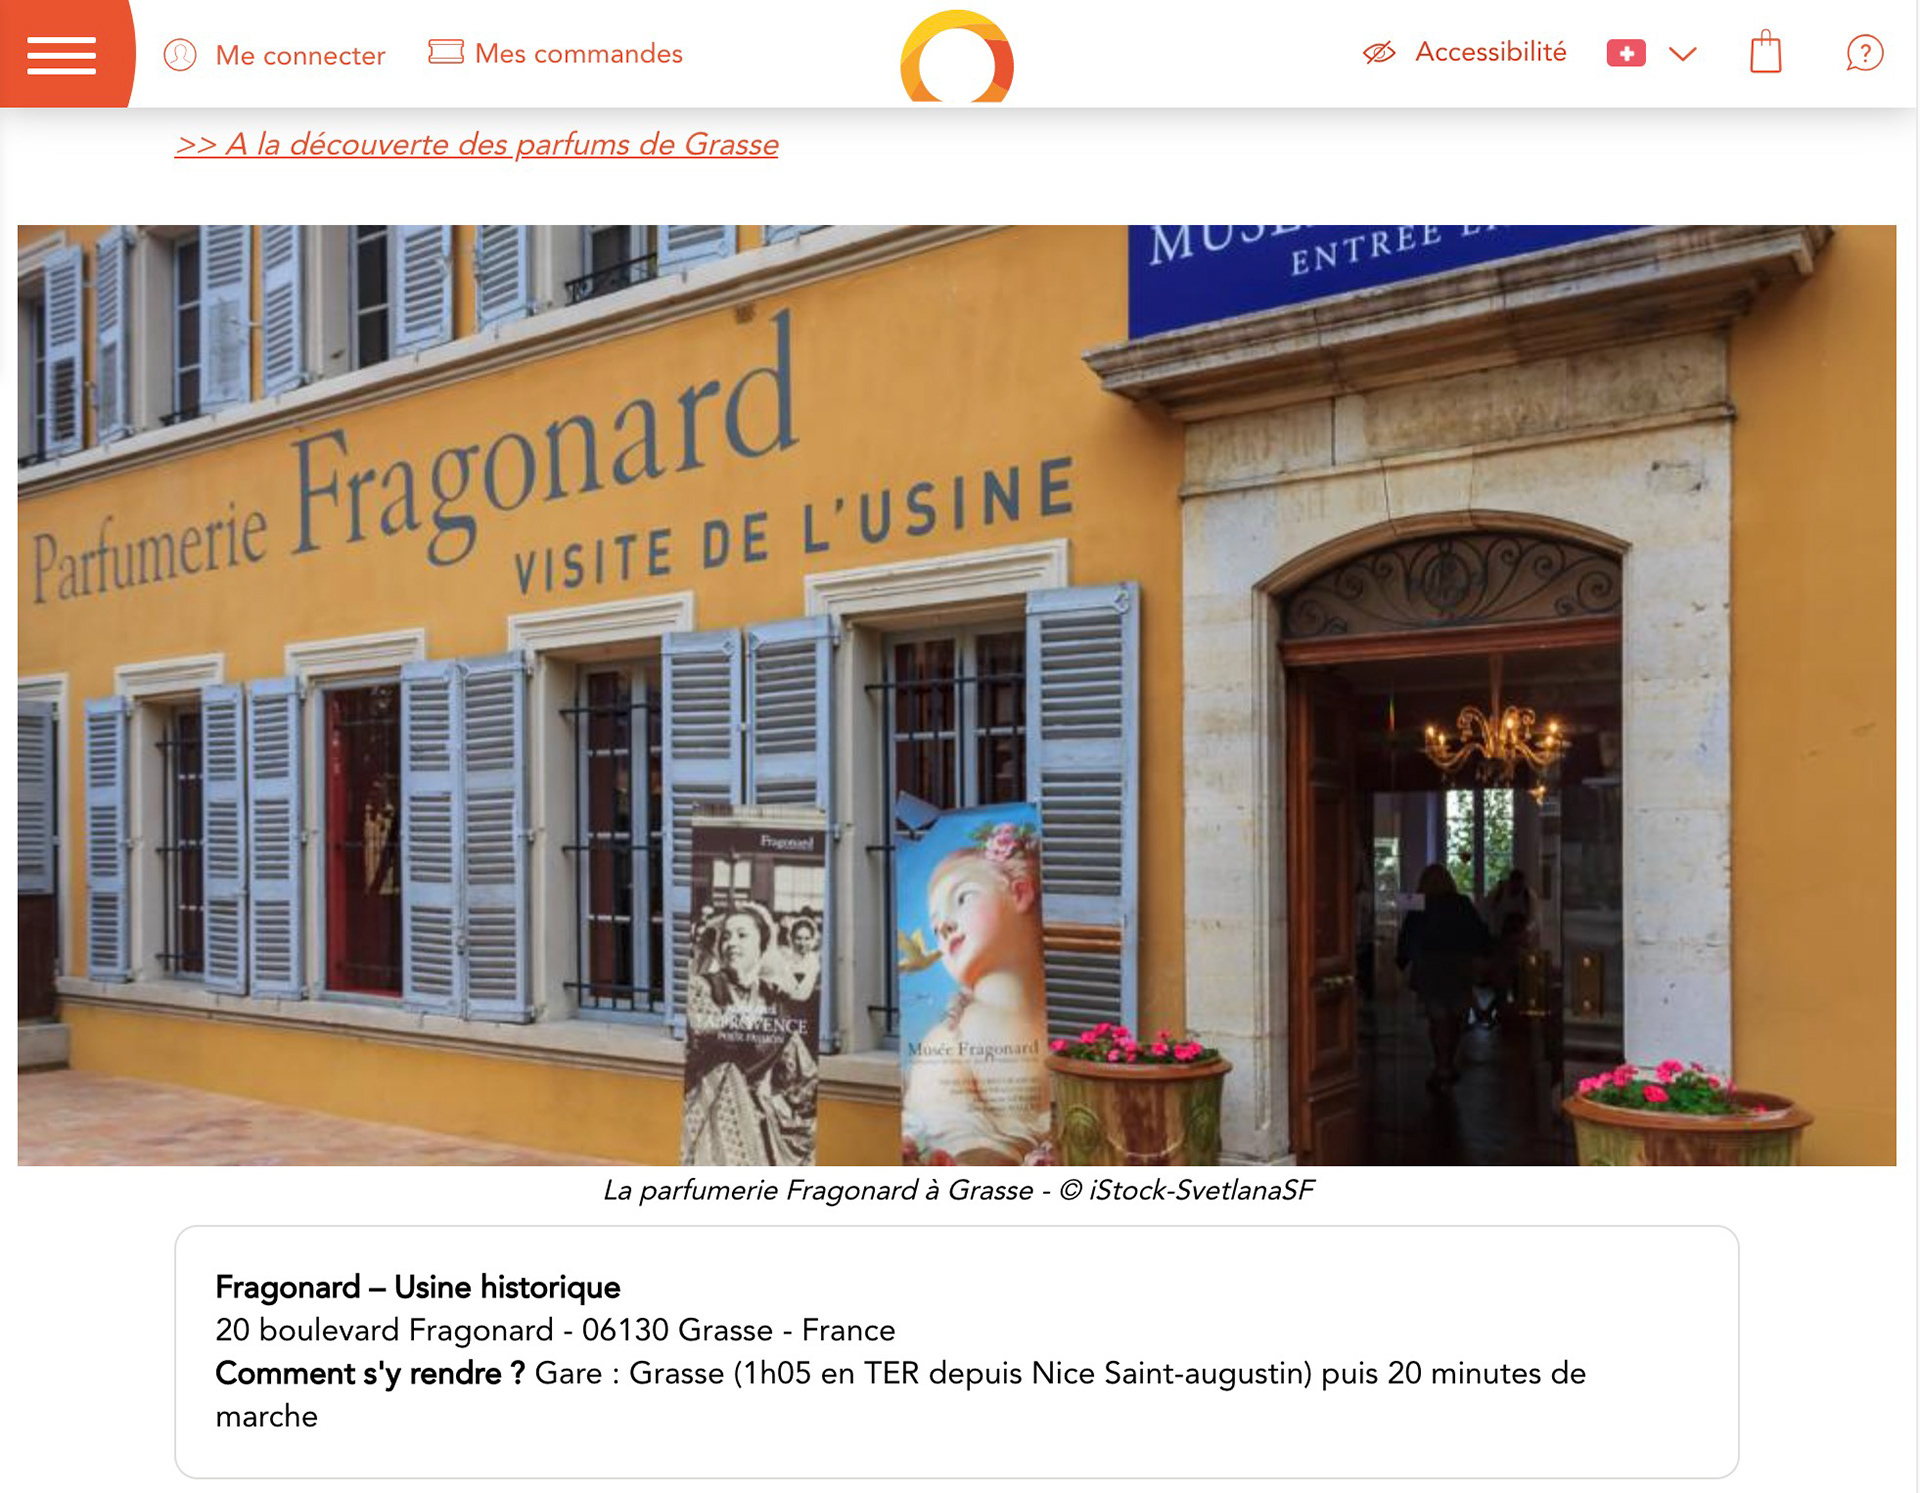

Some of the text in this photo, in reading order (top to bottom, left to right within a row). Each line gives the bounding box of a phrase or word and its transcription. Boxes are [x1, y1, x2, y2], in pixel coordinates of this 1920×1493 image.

[215, 44, 387, 66] Me connecter
[475, 41, 683, 64] Mes commandes
[1415, 38, 1567, 62] Accessibilité
[224, 131, 248, 156] A
[257, 129, 281, 156] la
[290, 130, 449, 156] découverte
[458, 130, 508, 156] des
[514, 129, 631, 162] parfums
[639, 129, 676, 156] de
[685, 131, 780, 156] Grasse
[33, 308, 800, 605] Parfumerie Fragonard
[515, 456, 1074, 595] VISITE DE L'USINE
[958, 1038, 1040, 1063] Fragonard
[603, 1178, 632, 1201] La
[637, 1177, 779, 1207] parfumerie
[786, 1177, 921, 1208] Fragonard
[925, 1178, 940, 1201] à
[948, 1178, 1034, 1201] Grasse
[1089, 1177, 1317, 1201] iStock-SvetlanaSF
[216, 1272, 361, 1307] Fragonard
[395, 1273, 472, 1300] Usine
[481, 1272, 622, 1306] historique
[215, 1317, 250, 1342] 20
[260, 1315, 399, 1342] boulevard
[410, 1315, 553, 1349] Fragonard
[582, 1317, 669, 1342] 06130
[678, 1316, 773, 1342] Grasse
[803, 1317, 896, 1342] France
[215, 1359, 357, 1386] Comment
[363, 1359, 402, 1393] s'y
[410, 1358, 503, 1386] rendre
[510, 1359, 526, 1386] ?
[535, 1359, 603, 1385] Gare
[629, 1359, 725, 1385] Grasse
[734, 1358, 811, 1389] (1h05
[821, 1367, 854, 1385] en
[863, 1360, 919, 1385] TER
[929, 1358, 1023, 1392] depuis
[1032, 1359, 1095, 1385] Nice
[1105, 1359, 1312, 1392] Saint-augustin)
[1322, 1360, 1379, 1392] puis
[1387, 1360, 1422, 1385] 20
[1431, 1360, 1542, 1385] minutes
[1551, 1358, 1587, 1385] de
[216, 1401, 318, 1428] marche
